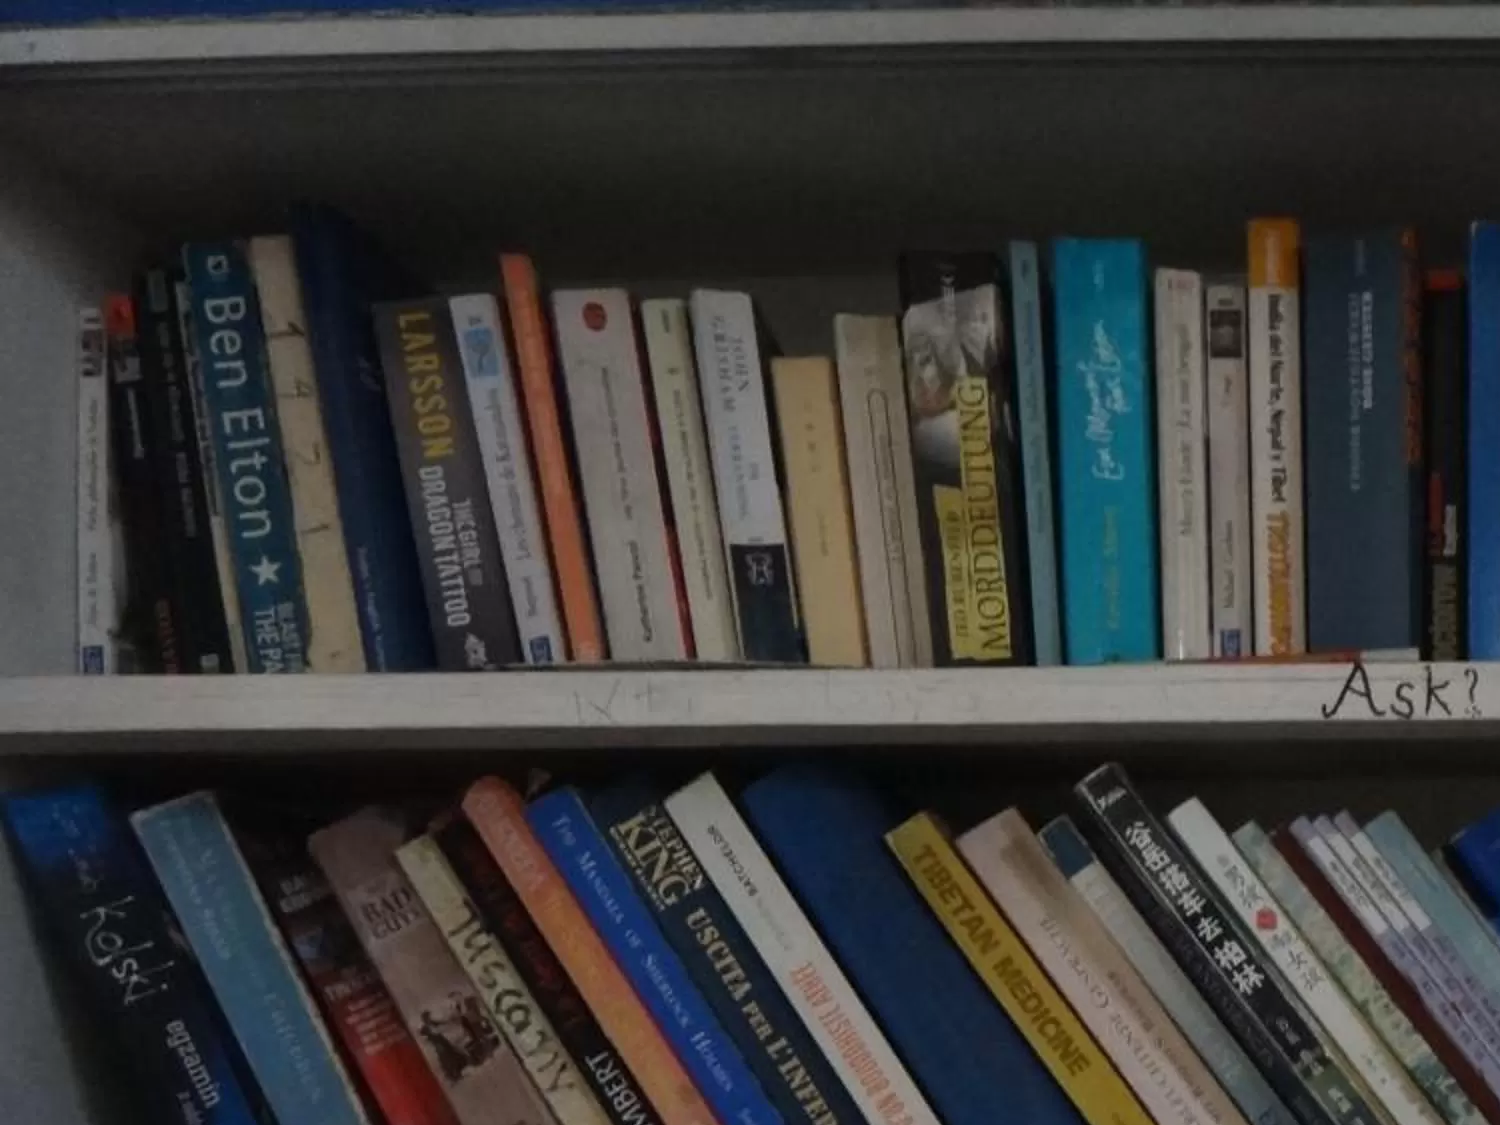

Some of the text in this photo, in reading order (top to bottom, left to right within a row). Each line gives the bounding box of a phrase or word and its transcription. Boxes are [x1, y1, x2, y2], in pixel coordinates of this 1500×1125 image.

[201, 292, 285, 540] Ben Elton
[396, 308, 458, 462] LARSSON
[417, 464, 471, 628] DRAGON TATTOO
[958, 382, 1008, 651] MORDDEUTUNG
[251, 607, 285, 675] THE PA
[1322, 659, 1482, 719] Ask?
[616, 810, 693, 910] KING
[644, 804, 705, 893] STEPHEN
[80, 894, 176, 1007] Kolski
[359, 884, 413, 924] BAD
[369, 903, 422, 941] GUYS
[683, 906, 754, 1001] USCITA
[739, 998, 775, 1040] PER
[909, 841, 1091, 1078] TIBETAN MEDICINE
[164, 1018, 220, 1111] egzamin
